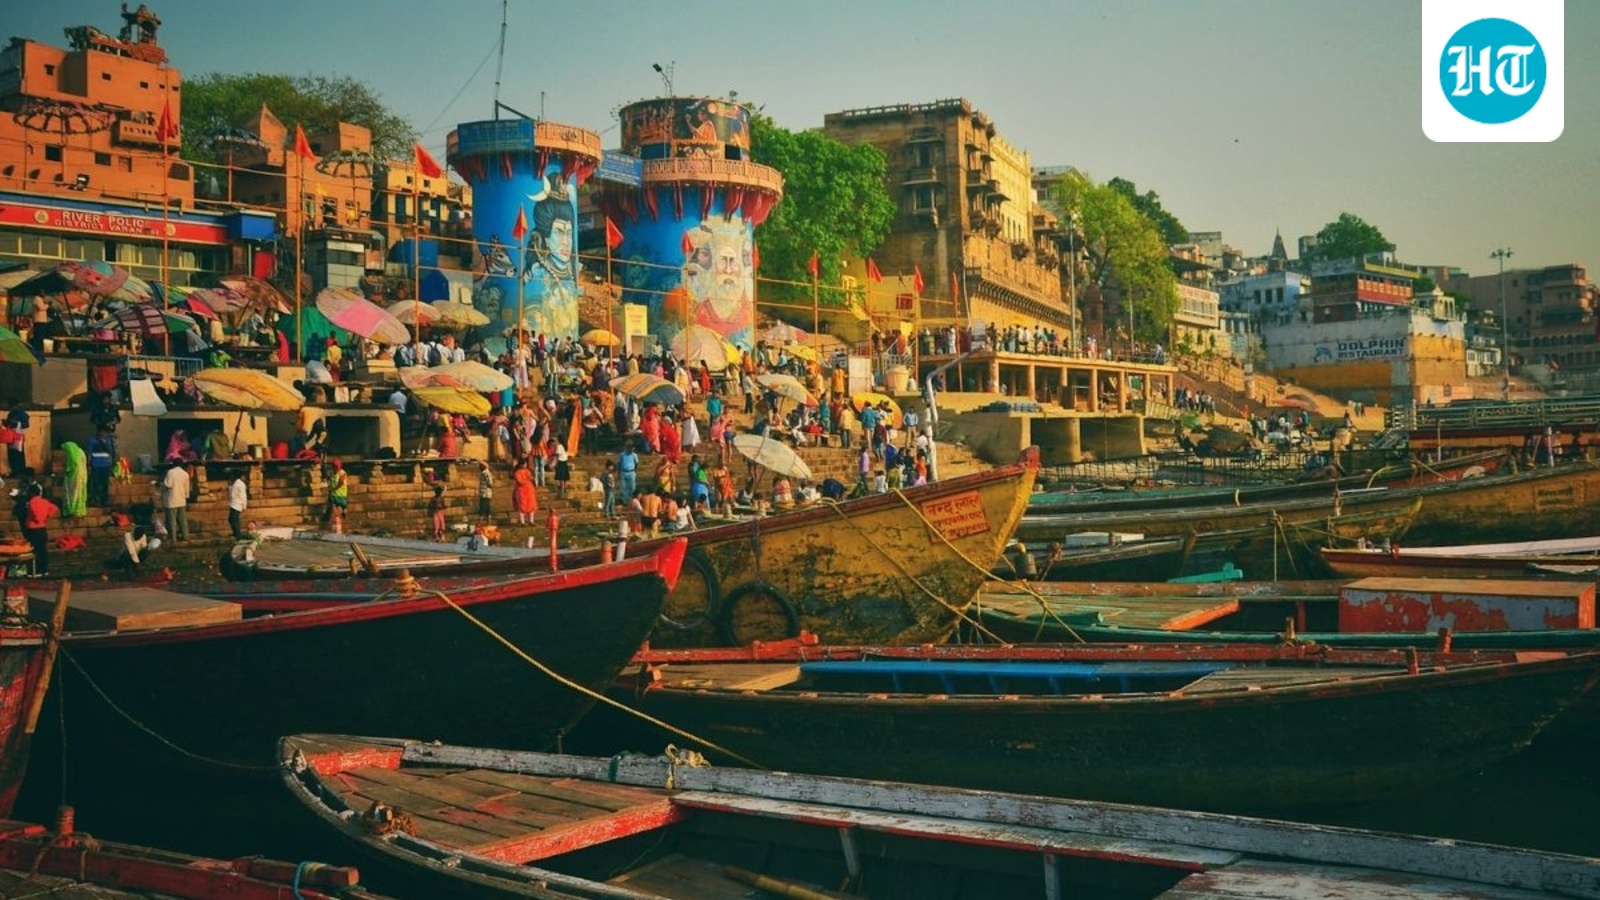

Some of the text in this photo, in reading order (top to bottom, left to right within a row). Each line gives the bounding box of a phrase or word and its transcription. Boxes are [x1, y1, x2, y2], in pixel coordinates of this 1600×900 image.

[62, 211, 149, 228] RIVER POLIC
[55, 219, 159, 235] DISTRICT VARANSI
[1338, 339, 1404, 352] DOLPHIN
[1338, 348, 1404, 358] RESTAURANT
